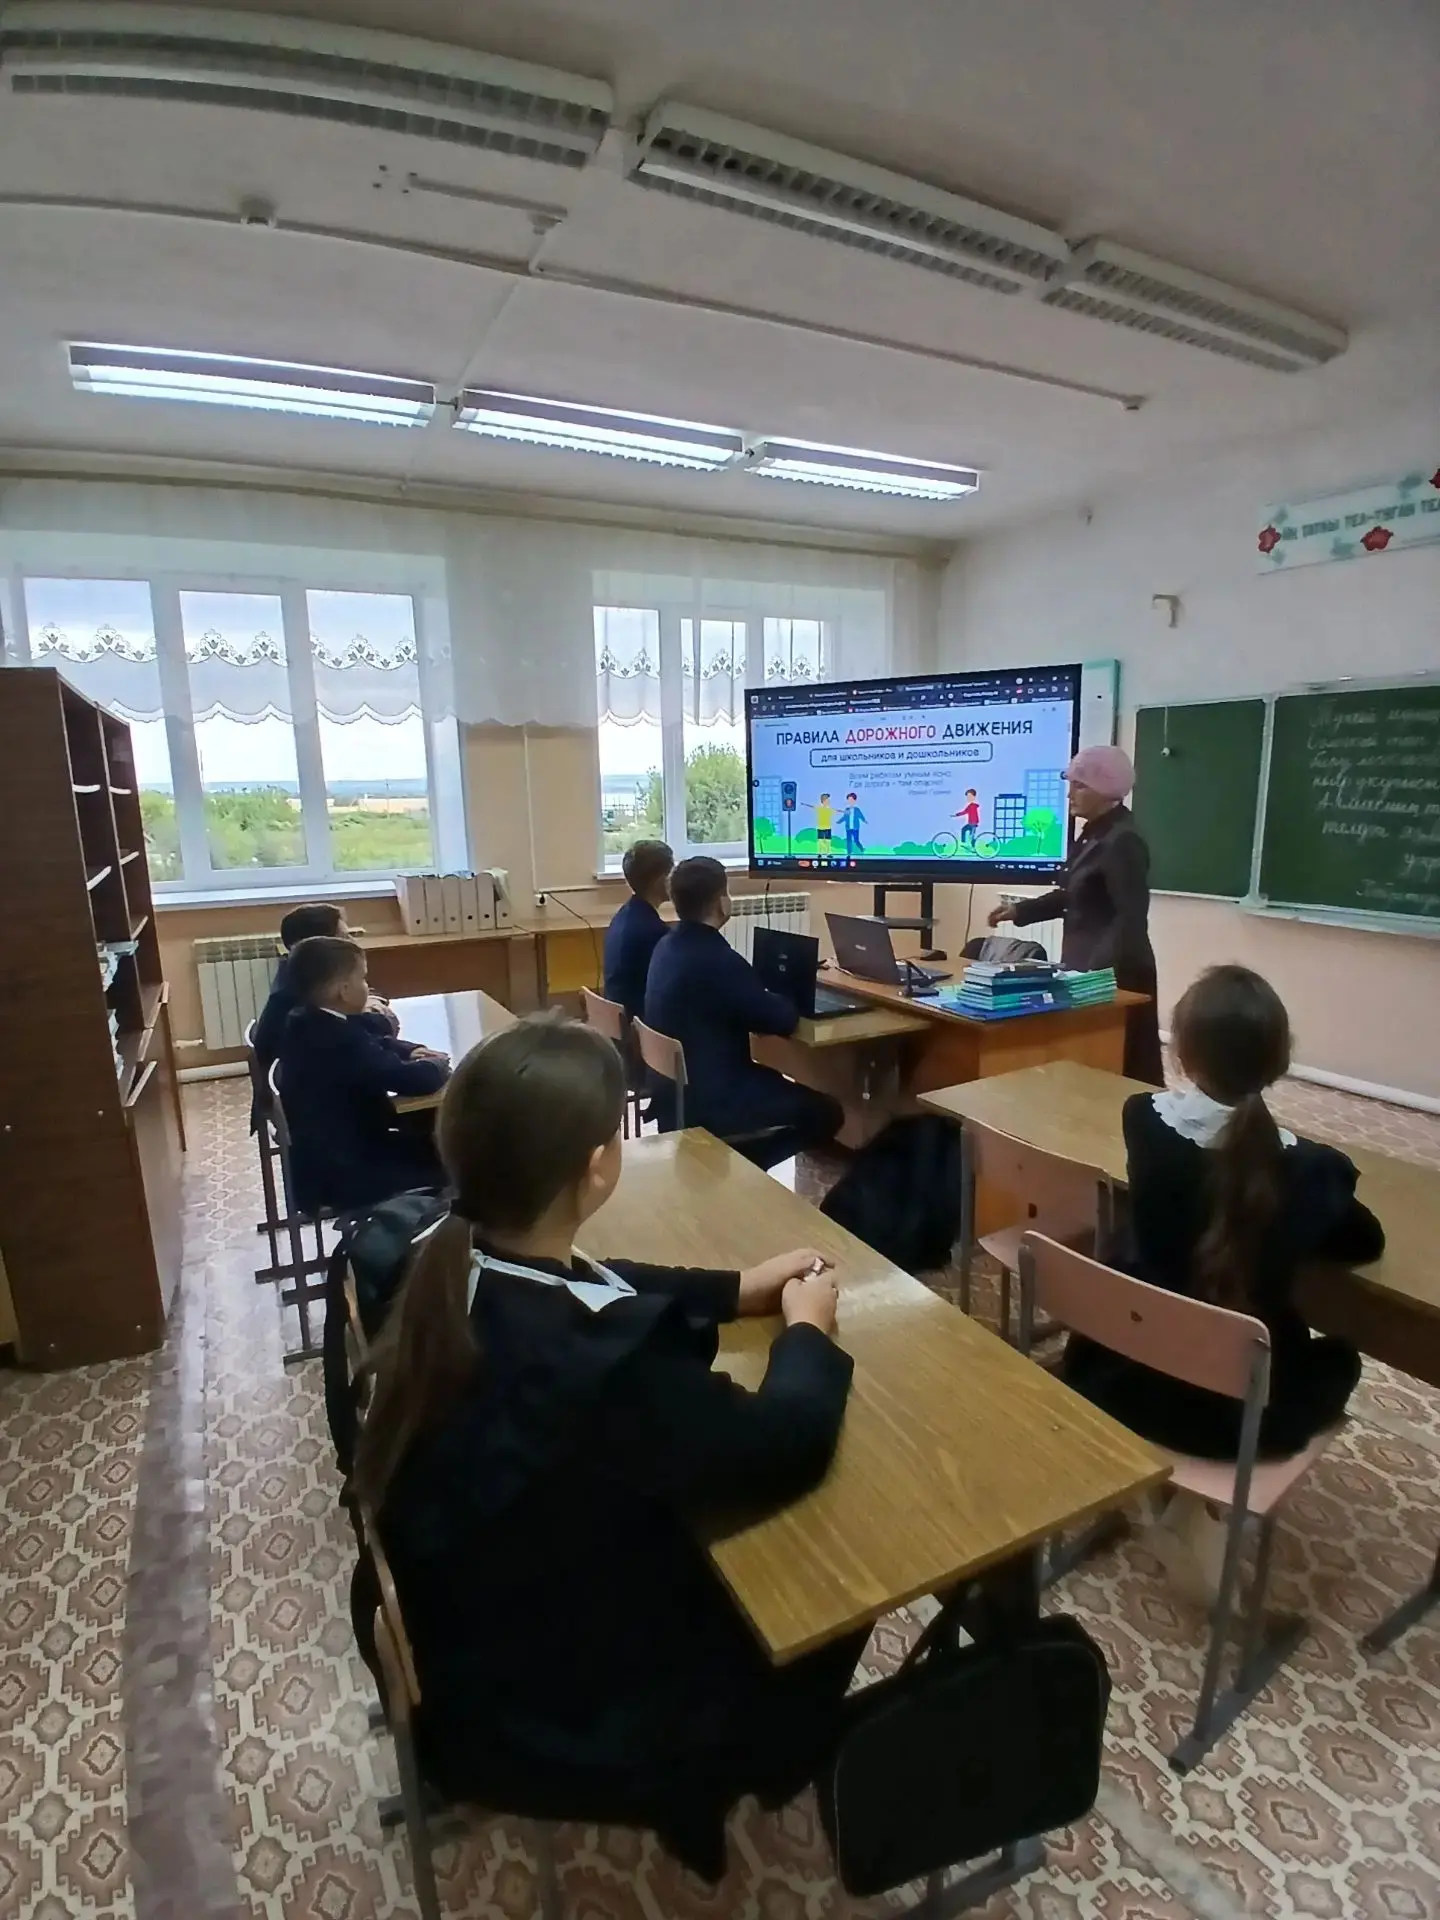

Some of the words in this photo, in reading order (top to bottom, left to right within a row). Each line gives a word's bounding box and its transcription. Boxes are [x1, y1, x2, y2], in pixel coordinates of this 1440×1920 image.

[776, 729, 840, 746] ПРАВИЛА
[845, 725, 936, 744] ДОРОЖНОГО
[942, 720, 1033, 740] ДВИЖЕНИЯ
[821, 754, 838, 763] для
[840, 751, 896, 761] школьников
[906, 748, 979, 760] дошкольников
